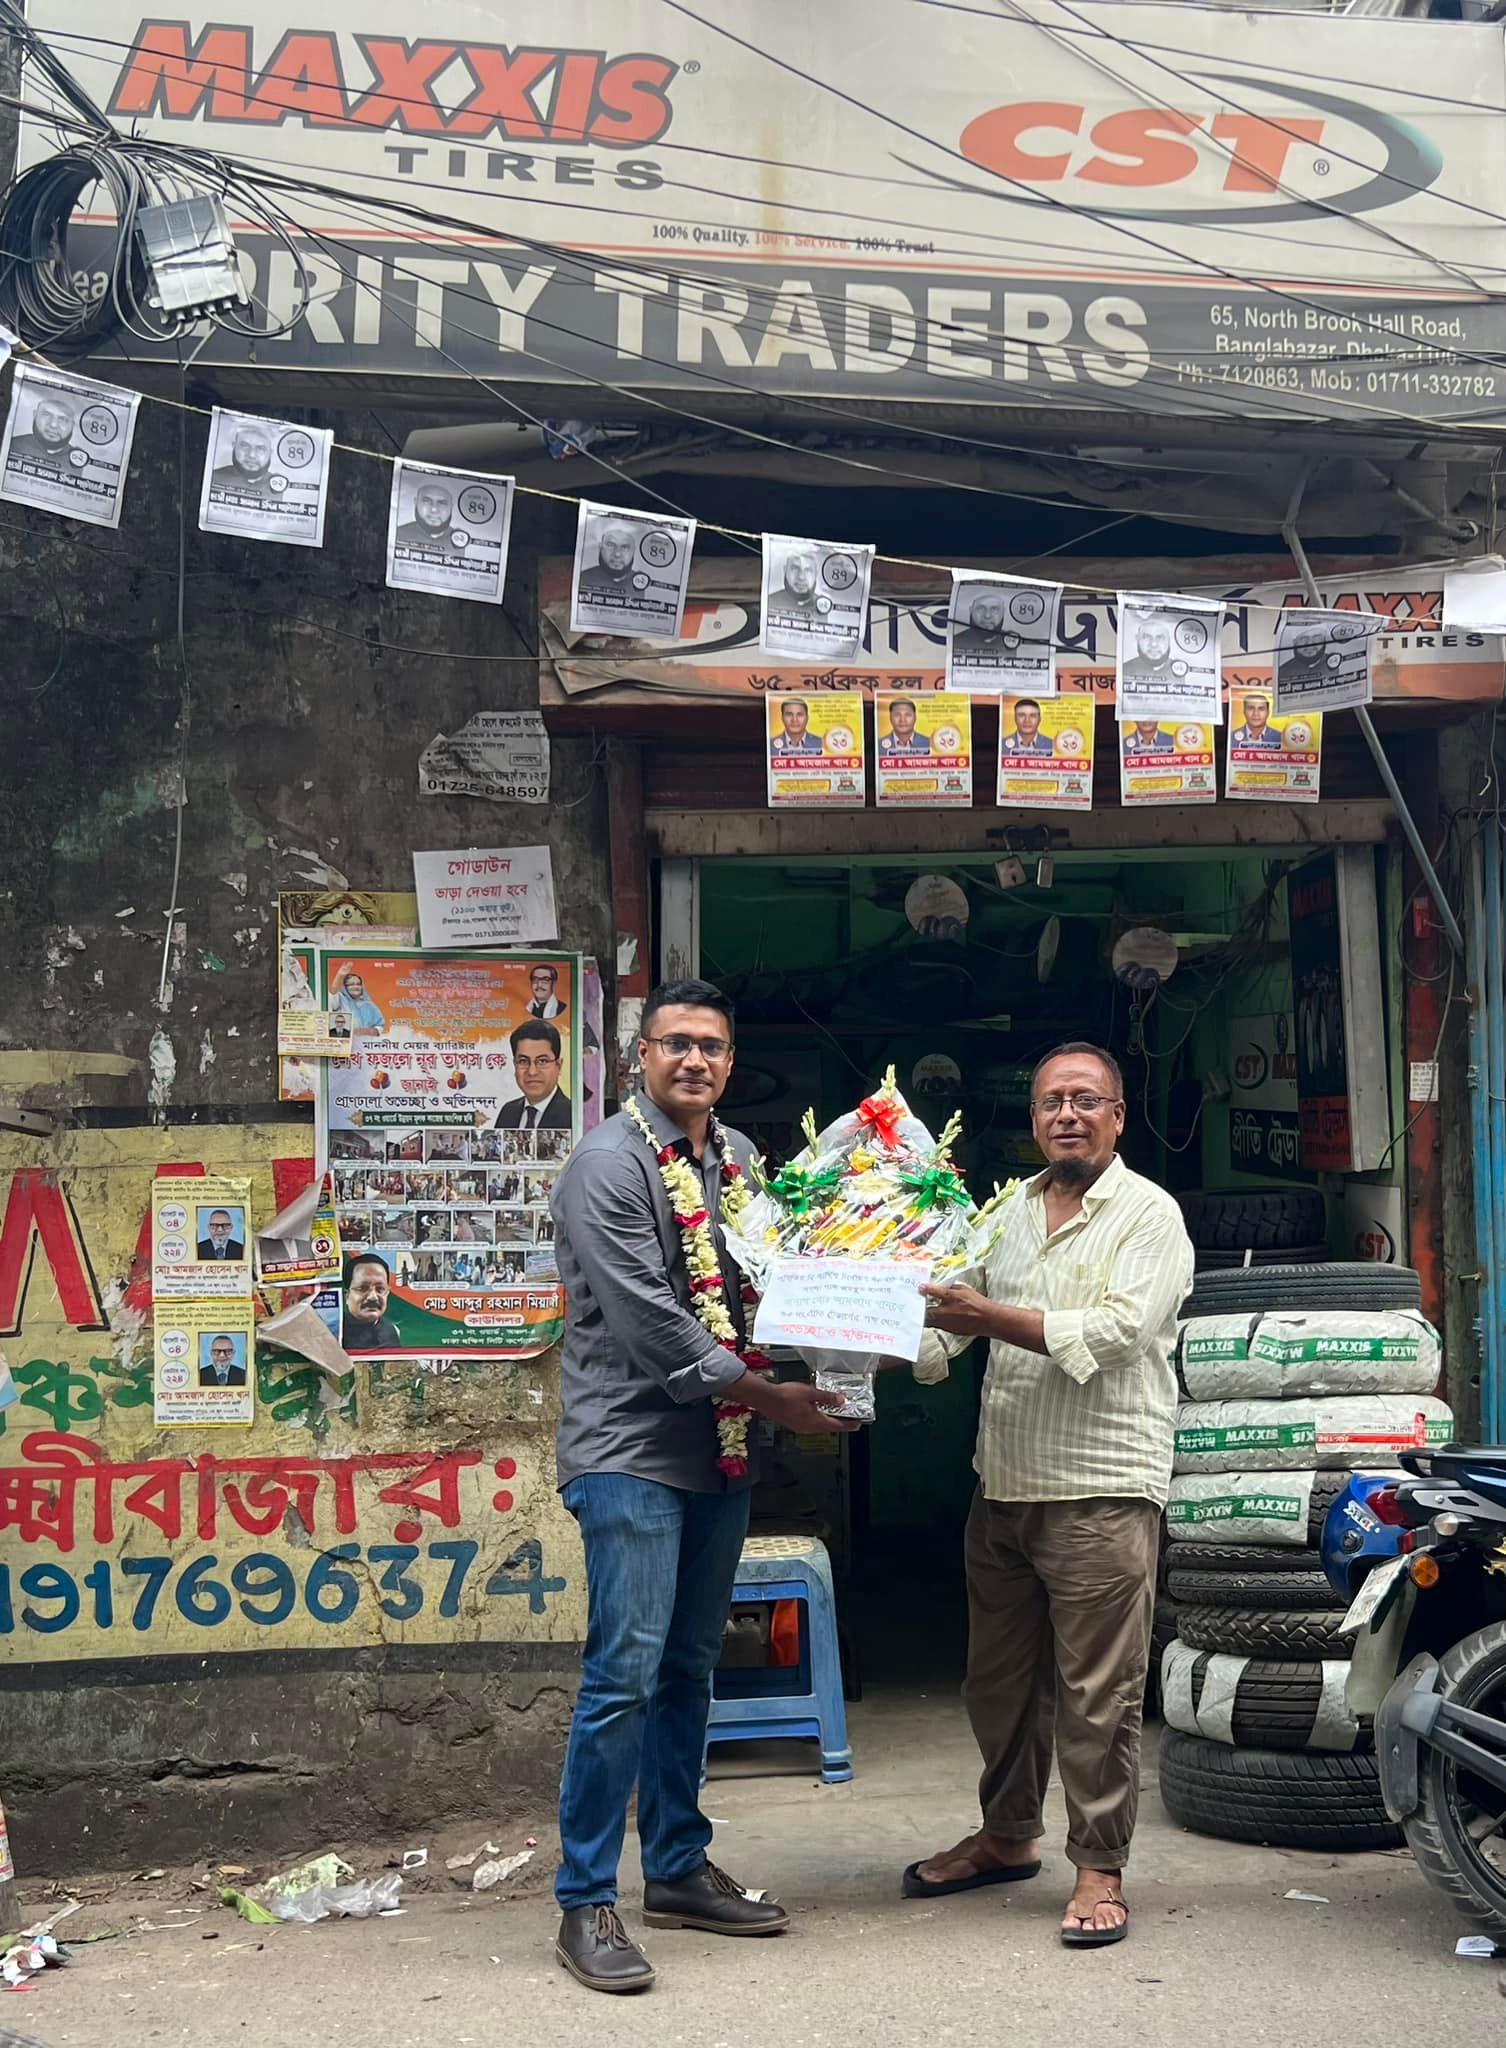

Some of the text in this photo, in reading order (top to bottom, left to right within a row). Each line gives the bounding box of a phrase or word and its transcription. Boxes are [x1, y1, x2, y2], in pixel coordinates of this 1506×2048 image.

[107, 19, 680, 149] MAXXIS
[958, 100, 1326, 194] CST
[384, 145, 666, 190] TIRES
[652, 225, 688, 240] 100%
[692, 227, 749, 247] Quality.
[594, 270, 1152, 388] TRADERS
[1211, 305, 1466, 341] 65, North Brook Hall Road,
[1367, 371, 1496, 397] 01711-332782
[1377, 633, 1485, 649] TIRES
[448, 855, 512, 877] গোডাউন
[435, 884, 528, 901] ভাড়া দেওয়া হবে
[1232, 1111, 1301, 1168] প্রীতি ট্রেডা
[424, 1296, 447, 1311] মোঃ
[487, 1296, 522, 1310] রহমান
[1189, 1340, 1236, 1355] MAXXIS
[1315, 1339, 1373, 1354] MAXXIS
[1225, 1428, 1279, 1442] MAXXIS
[1242, 1499, 1299, 1513] MAXXIS
